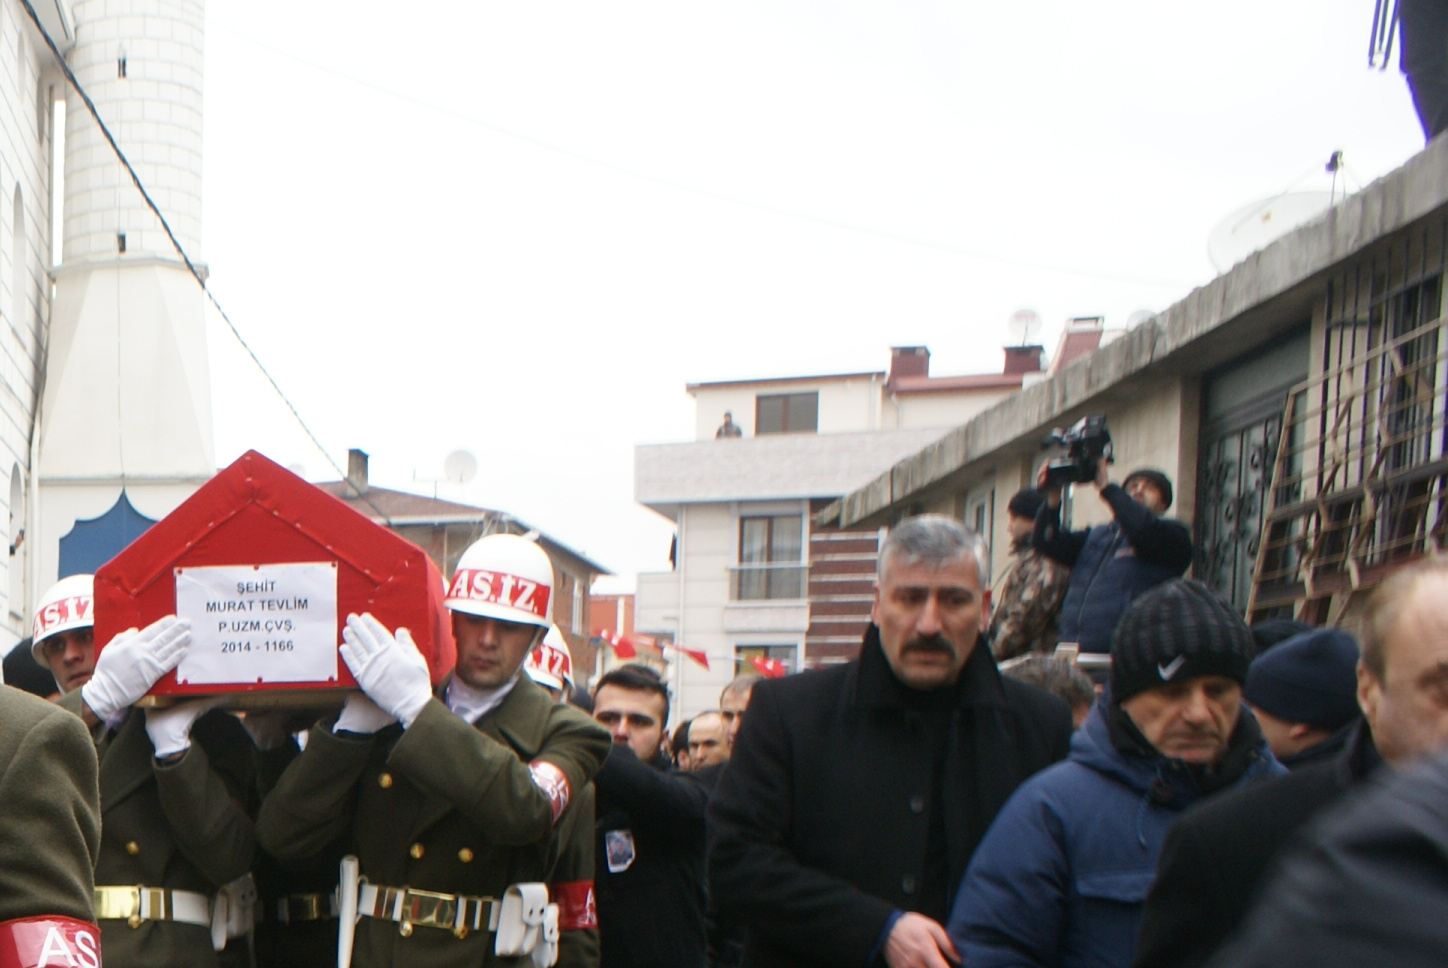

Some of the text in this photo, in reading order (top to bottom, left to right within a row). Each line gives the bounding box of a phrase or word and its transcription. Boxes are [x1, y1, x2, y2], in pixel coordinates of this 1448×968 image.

[236, 580, 277, 595] ŞEHİT
[206, 596, 309, 613] MURAT TEVLİM
[221, 641, 252, 653] 2014
[264, 640, 294, 652] 1166
